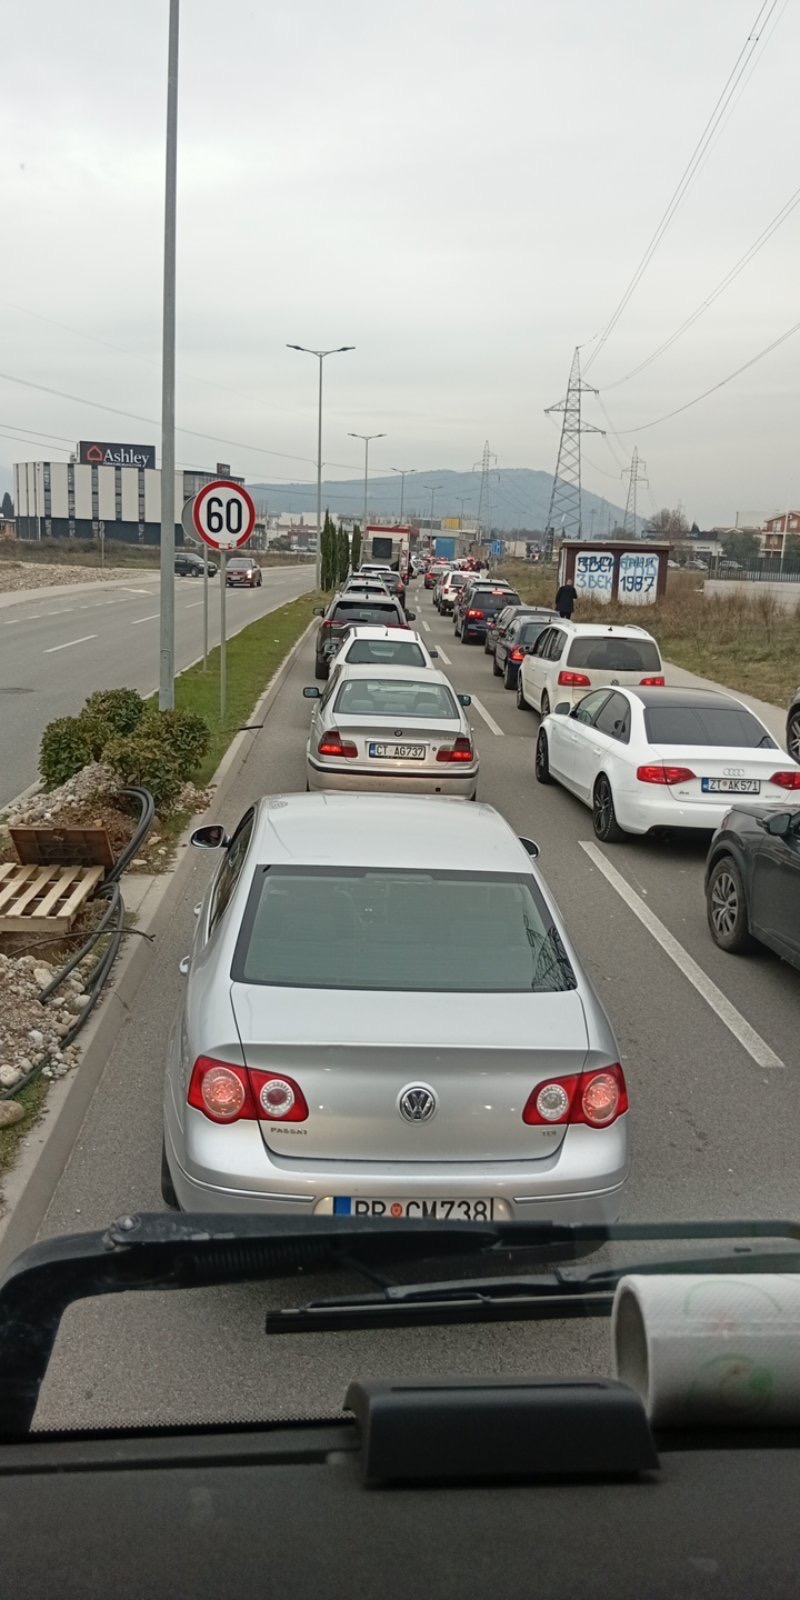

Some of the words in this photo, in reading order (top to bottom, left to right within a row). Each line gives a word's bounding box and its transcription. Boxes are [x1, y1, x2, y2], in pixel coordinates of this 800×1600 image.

[104, 448, 150, 468] Ashley
[207, 497, 243, 534] 60
[620, 576, 655, 593] 1987
[394, 746, 424, 757] AG737
[728, 780, 758, 791] AK571
